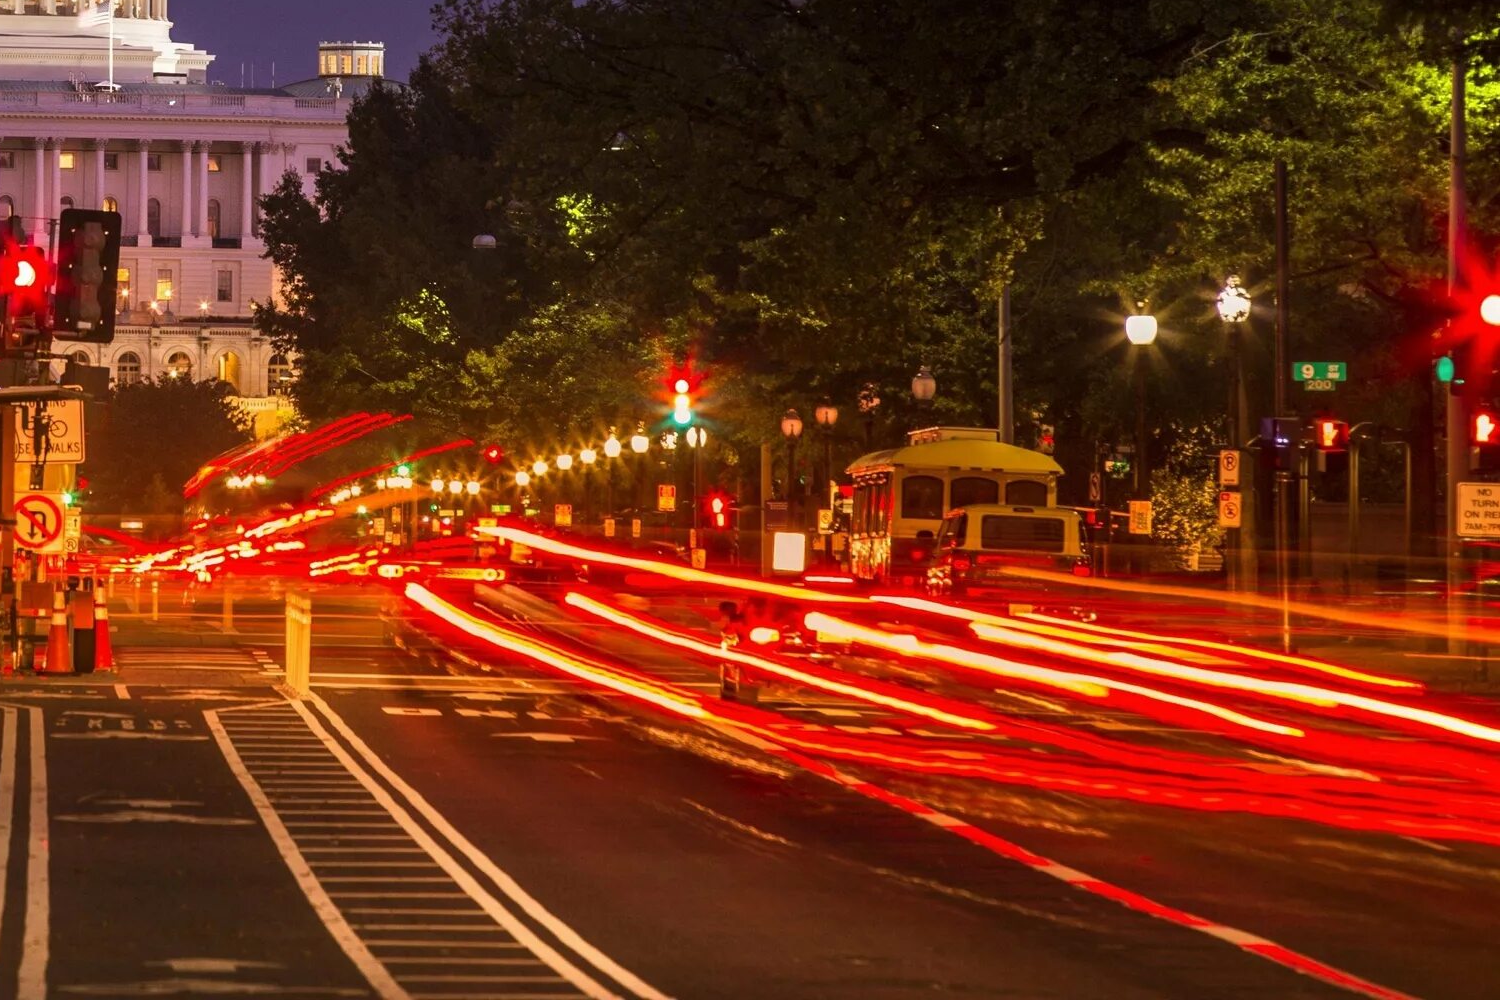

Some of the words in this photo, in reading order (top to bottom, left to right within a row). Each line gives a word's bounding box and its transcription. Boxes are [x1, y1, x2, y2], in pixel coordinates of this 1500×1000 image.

[1301, 364, 1314, 379] 9
[1307, 380, 1331, 390] 200
[1477, 488, 1493, 496] NO
[1471, 499, 1499, 507] TURN
